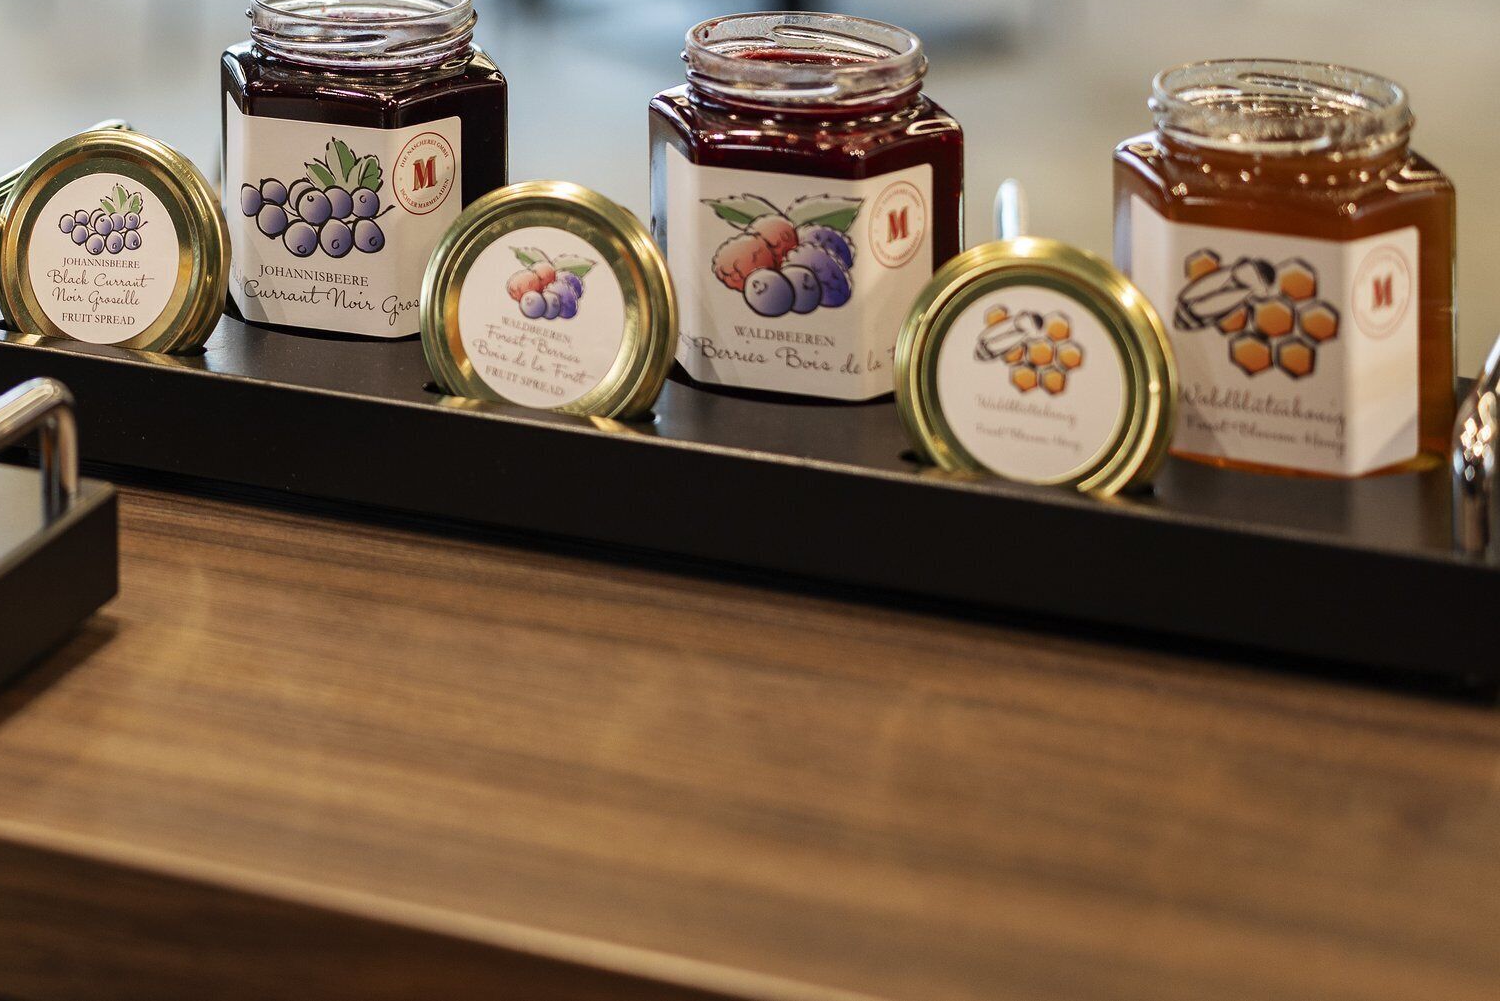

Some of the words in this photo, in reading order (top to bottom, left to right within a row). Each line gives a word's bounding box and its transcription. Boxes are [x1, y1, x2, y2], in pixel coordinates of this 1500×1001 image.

[412, 155, 438, 192] M
[886, 205, 909, 244] M
[62, 257, 140, 269] JOHANNISBEERE
[258, 264, 369, 287] JOHANNISBEERE
[47, 269, 89, 285] Black
[93, 273, 155, 288] Currant
[52, 287, 84, 302] Noir
[88, 289, 140, 312] Groseille
[244, 279, 329, 304] Currant
[326, 287, 376, 311] Noir
[381, 295, 420, 326] Gros
[62, 312, 93, 323] FRUIT
[94, 314, 136, 325] SPREAD
[501, 316, 572, 344] WALDBEEREN
[734, 325, 836, 347] WALDBEEREN
[530, 338, 580, 364] Berries
[692, 336, 768, 363] Berries
[775, 346, 831, 371] Bois
[839, 352, 860, 375] de
[867, 351, 882, 371] la
[485, 365, 518, 383] FRUIT
[520, 376, 565, 397] SPREAD
